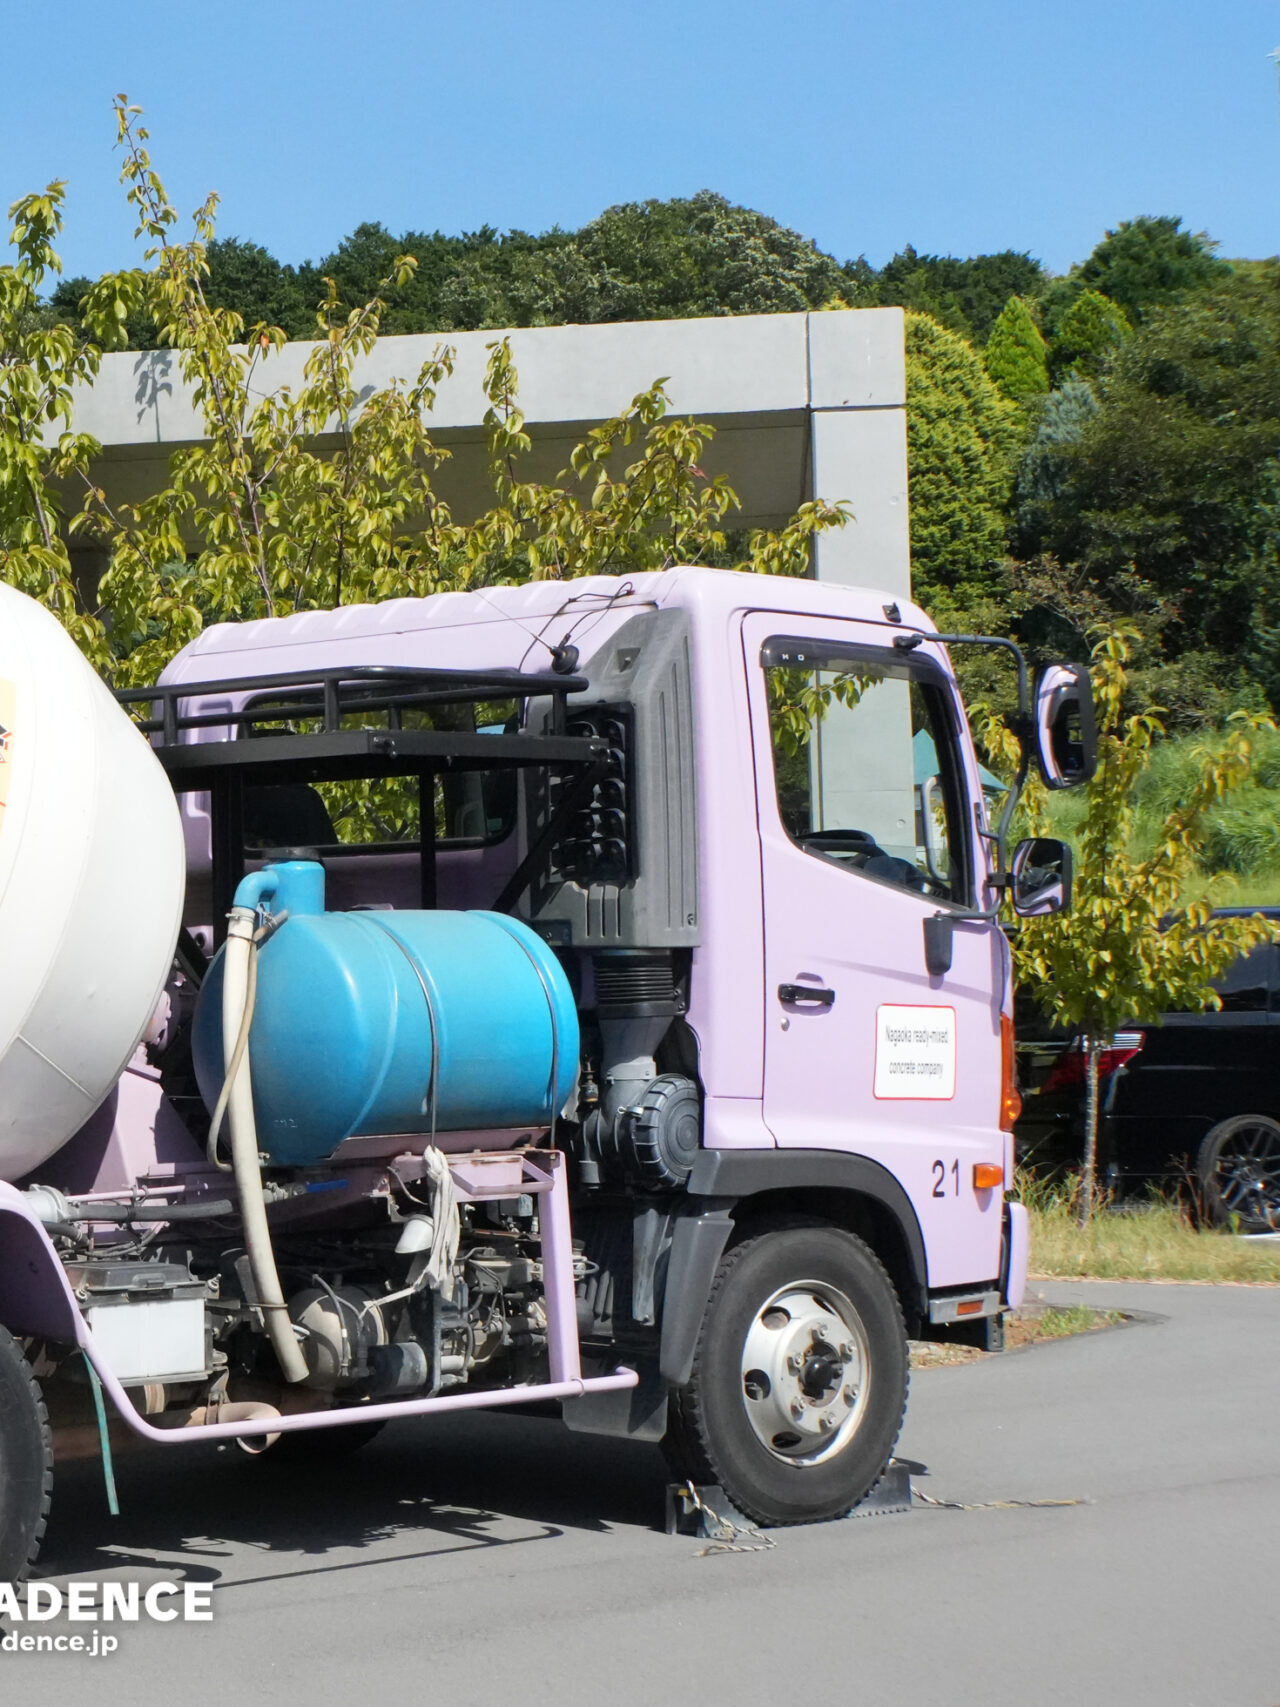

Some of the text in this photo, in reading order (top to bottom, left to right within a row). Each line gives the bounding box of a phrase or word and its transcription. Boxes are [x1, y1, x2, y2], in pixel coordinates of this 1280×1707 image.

[889, 1060, 944, 1079] concrete company
[931, 1158, 959, 1198] 21
